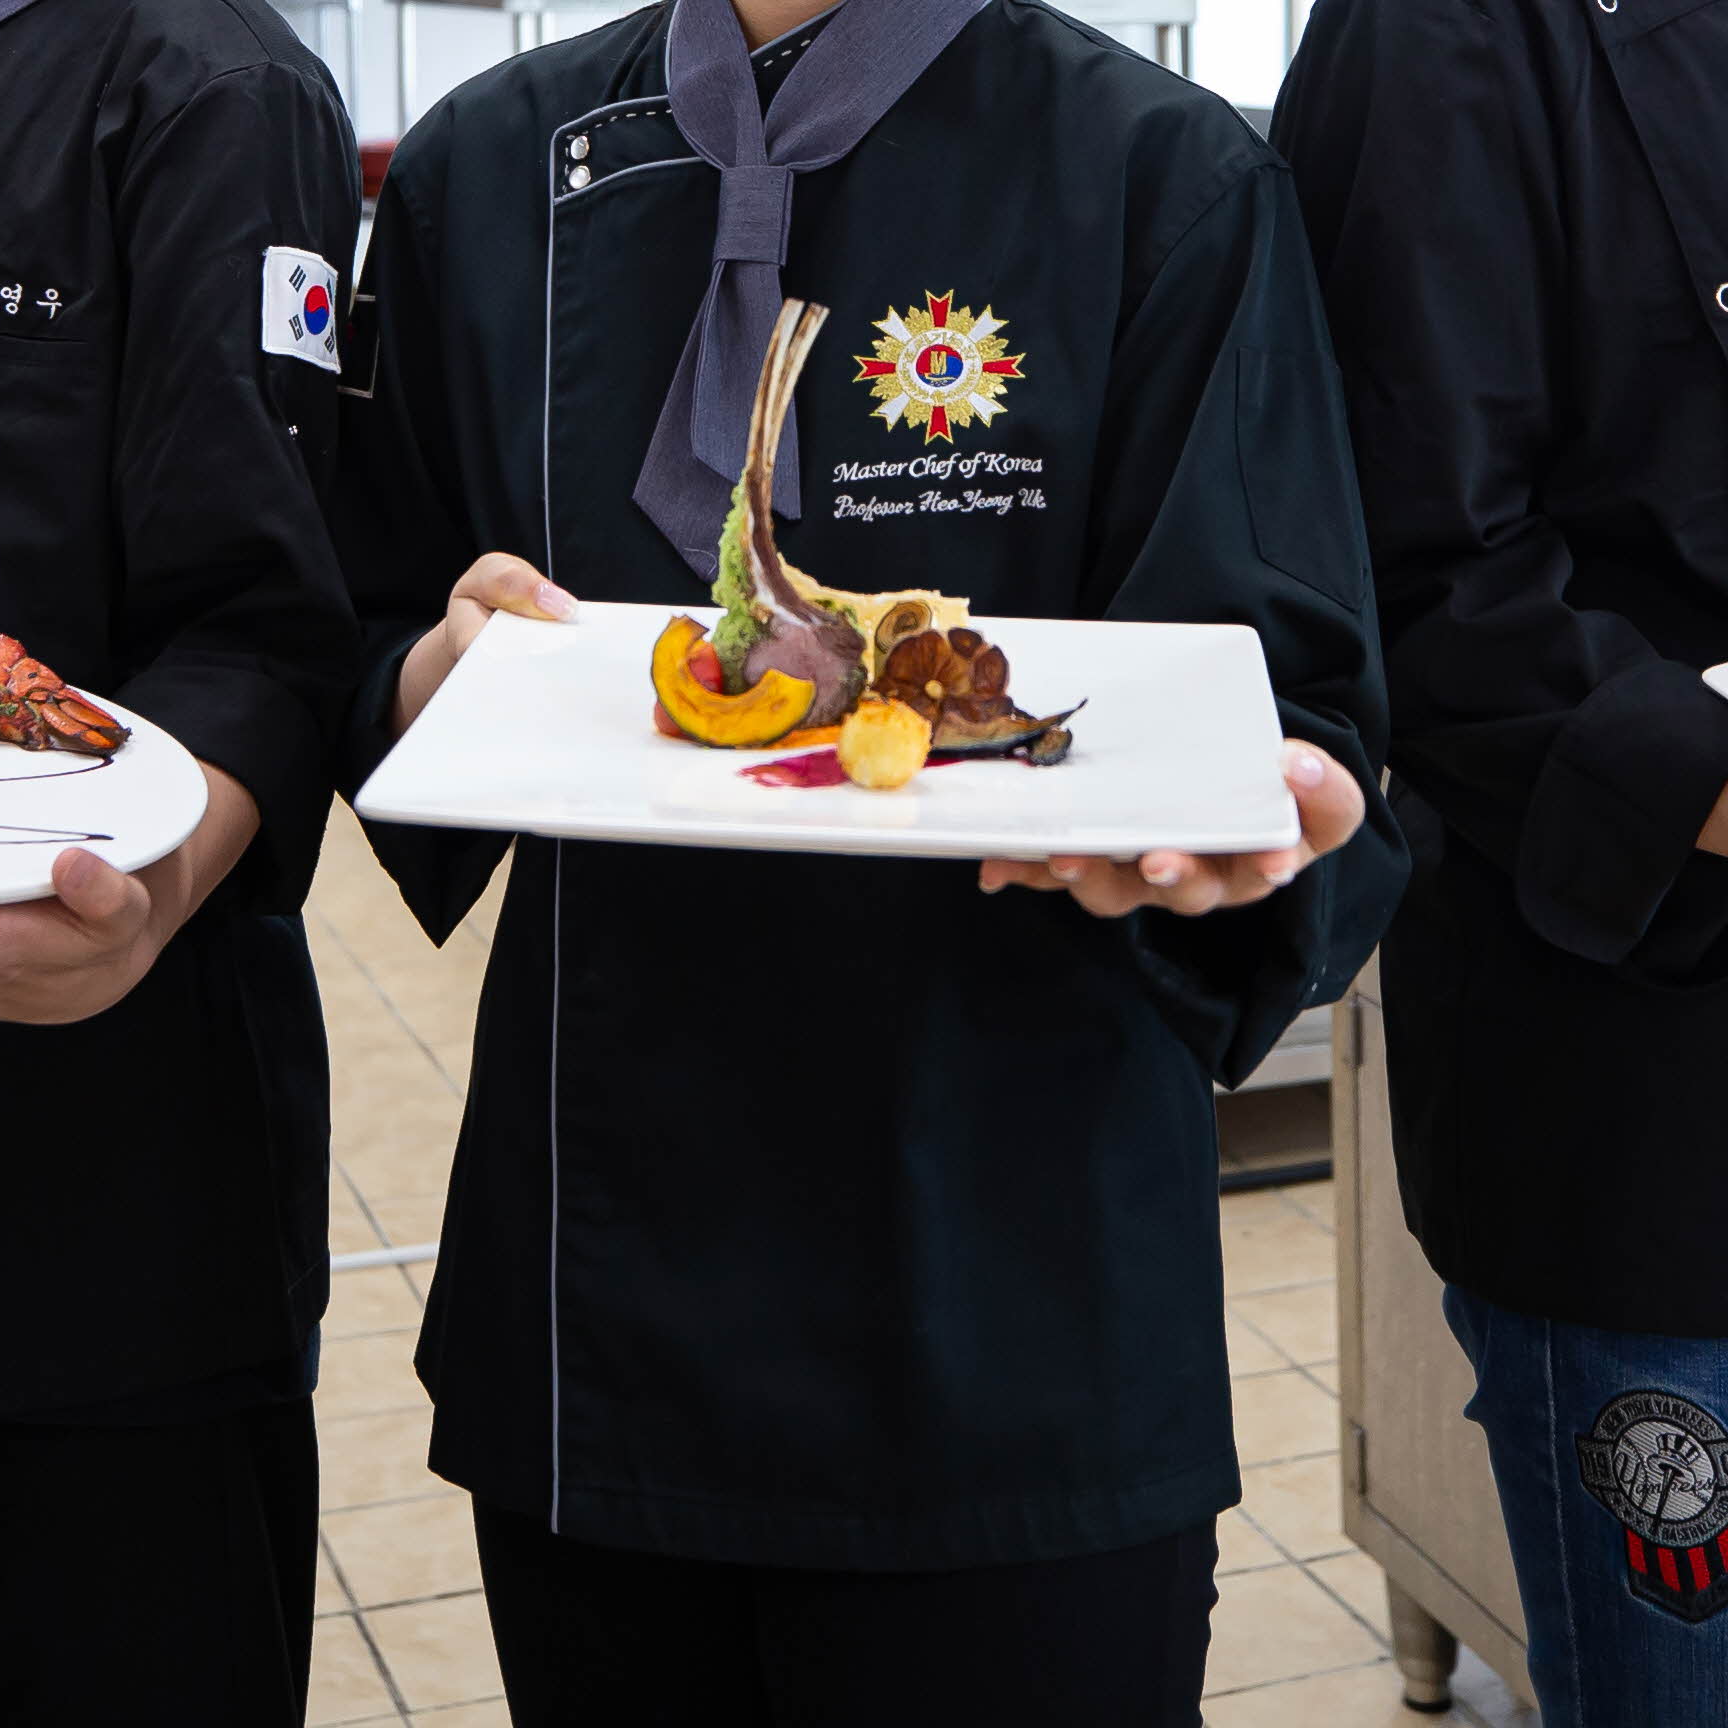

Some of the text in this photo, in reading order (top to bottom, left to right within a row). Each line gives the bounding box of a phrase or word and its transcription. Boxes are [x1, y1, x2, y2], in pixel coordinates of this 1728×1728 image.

[833, 452, 1043, 483] Master Chef of Korea
[833, 494, 914, 522] Professor
[918, 490, 960, 512] Heo
[1018, 488, 1047, 509] Uk
